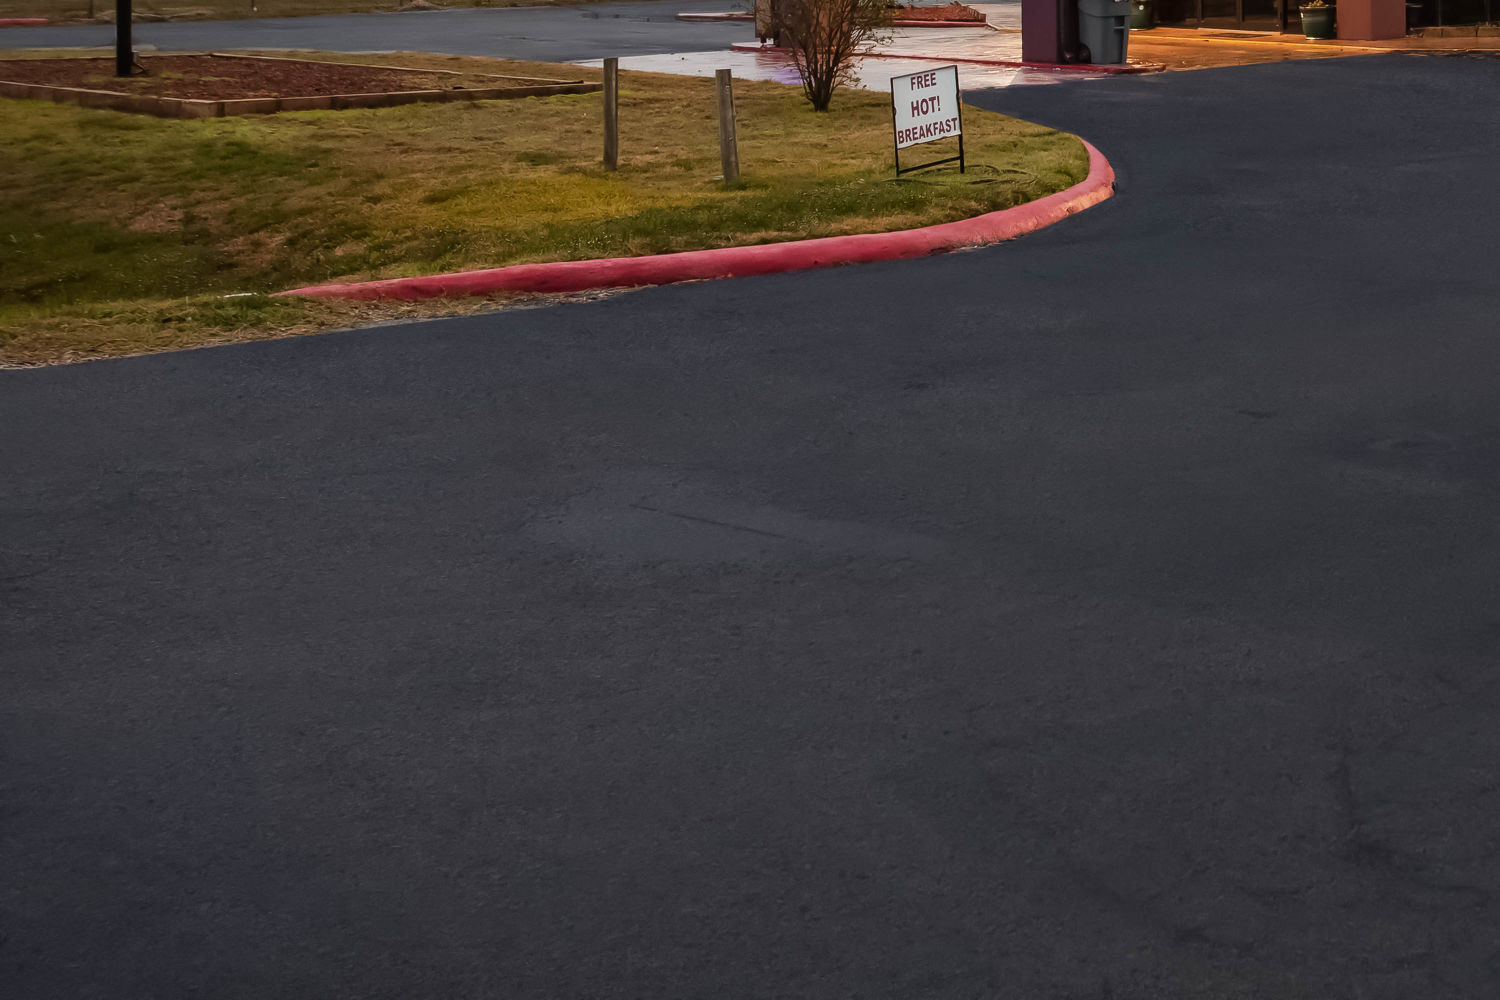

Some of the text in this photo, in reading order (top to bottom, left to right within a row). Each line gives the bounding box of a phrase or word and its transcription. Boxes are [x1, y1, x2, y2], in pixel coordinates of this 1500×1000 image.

[910, 72, 937, 91] FREE
[911, 96, 941, 118] HOT!
[897, 117, 958, 145] BREAKFAST
